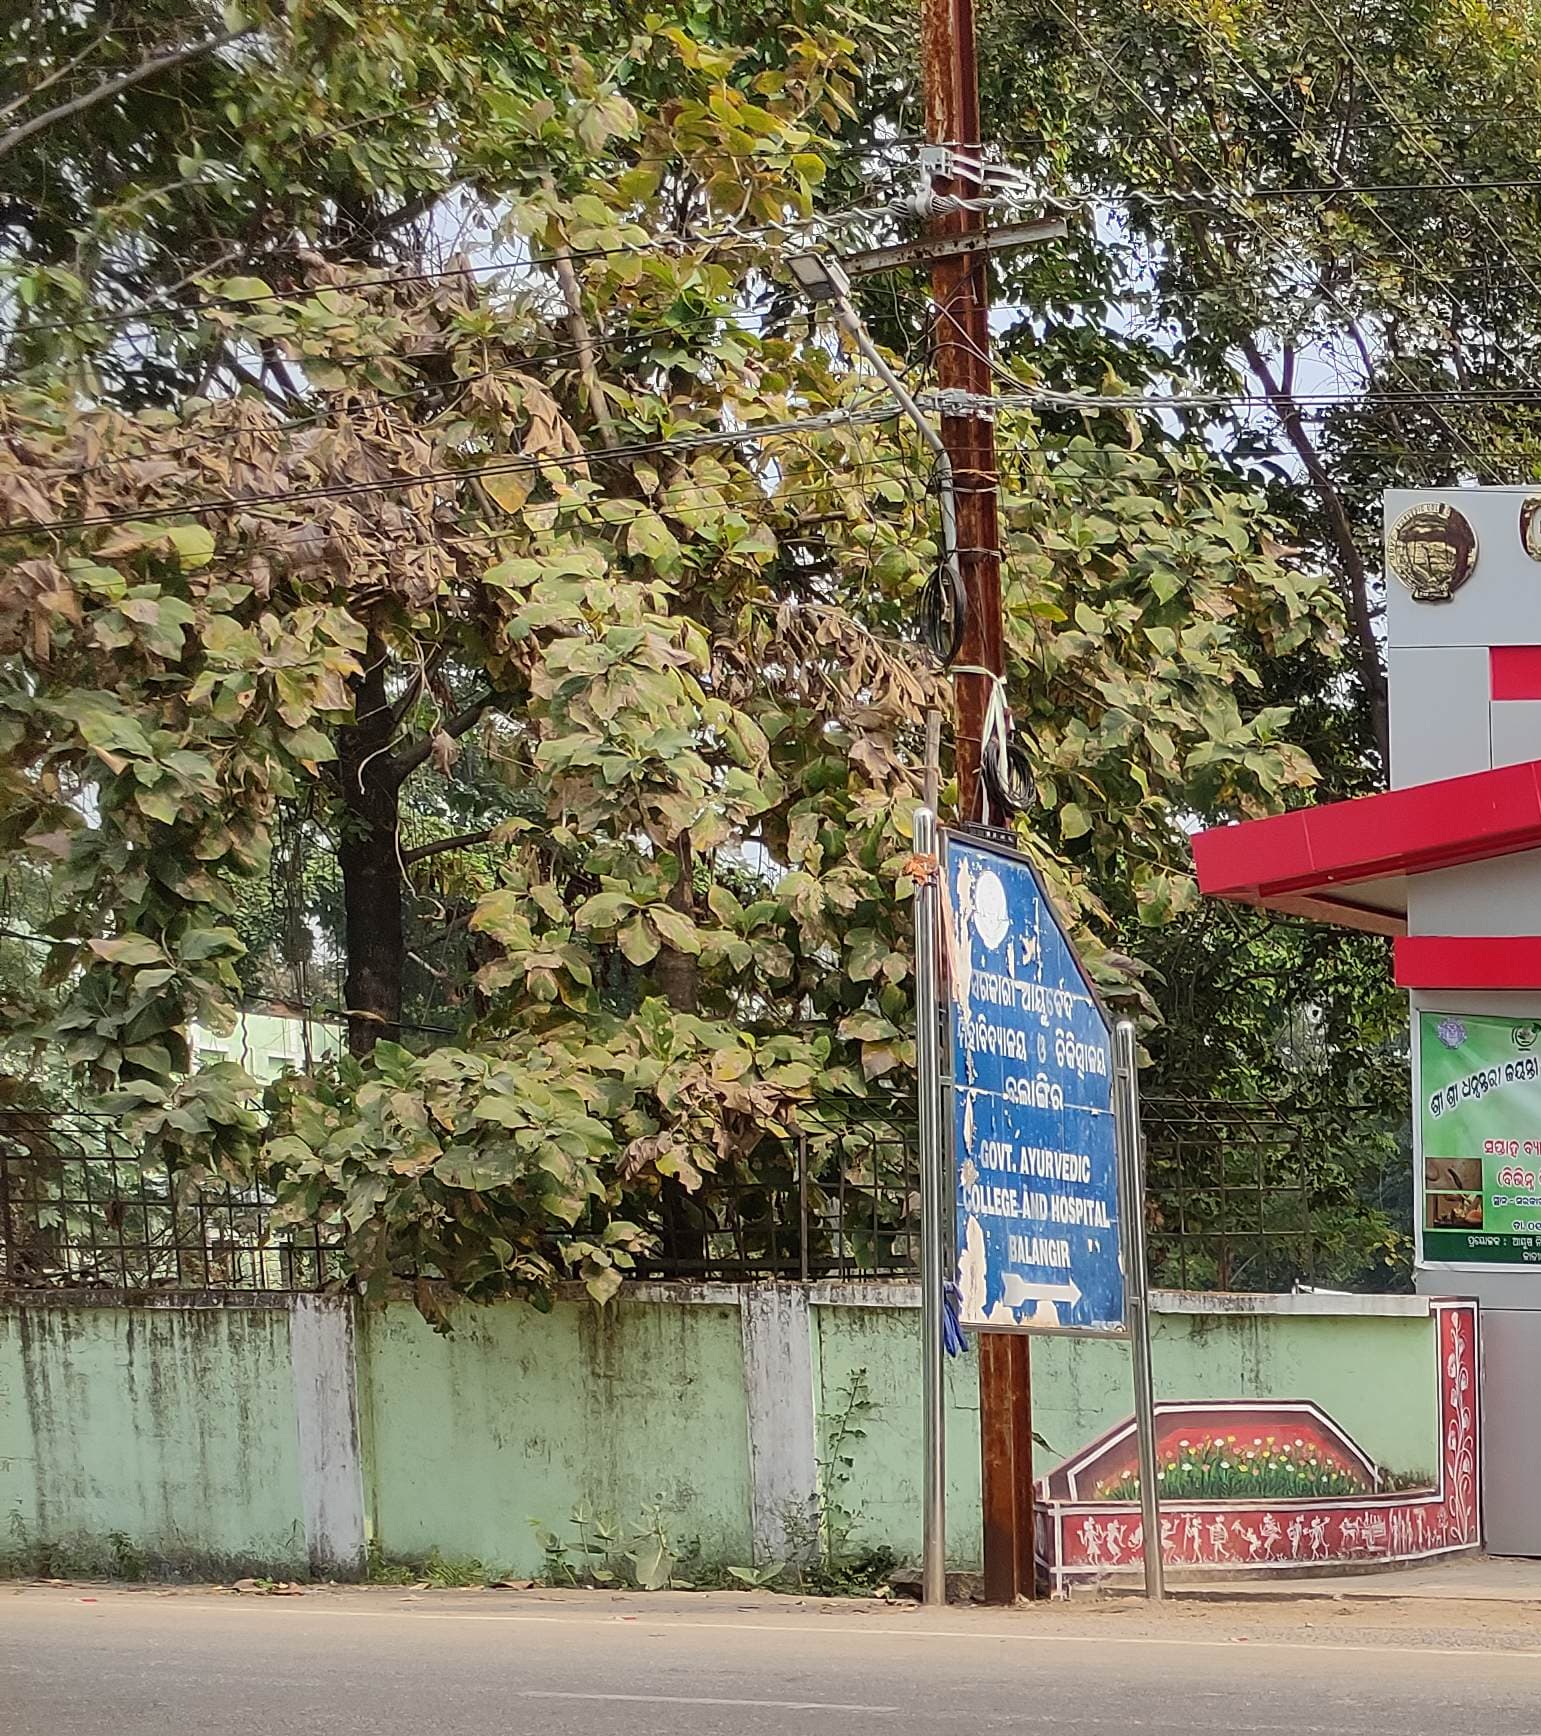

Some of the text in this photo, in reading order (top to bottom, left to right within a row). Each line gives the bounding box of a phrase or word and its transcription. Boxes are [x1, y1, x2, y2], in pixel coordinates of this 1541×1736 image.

[1036, 1032, 1046, 1064] ଓ
[980, 1140, 1091, 1183] GOVT. AYURVEDIC
[963, 1184, 1111, 1228] COLLEGE AND HOSPITAL
[1009, 1234, 1071, 1268] BALANGIR
